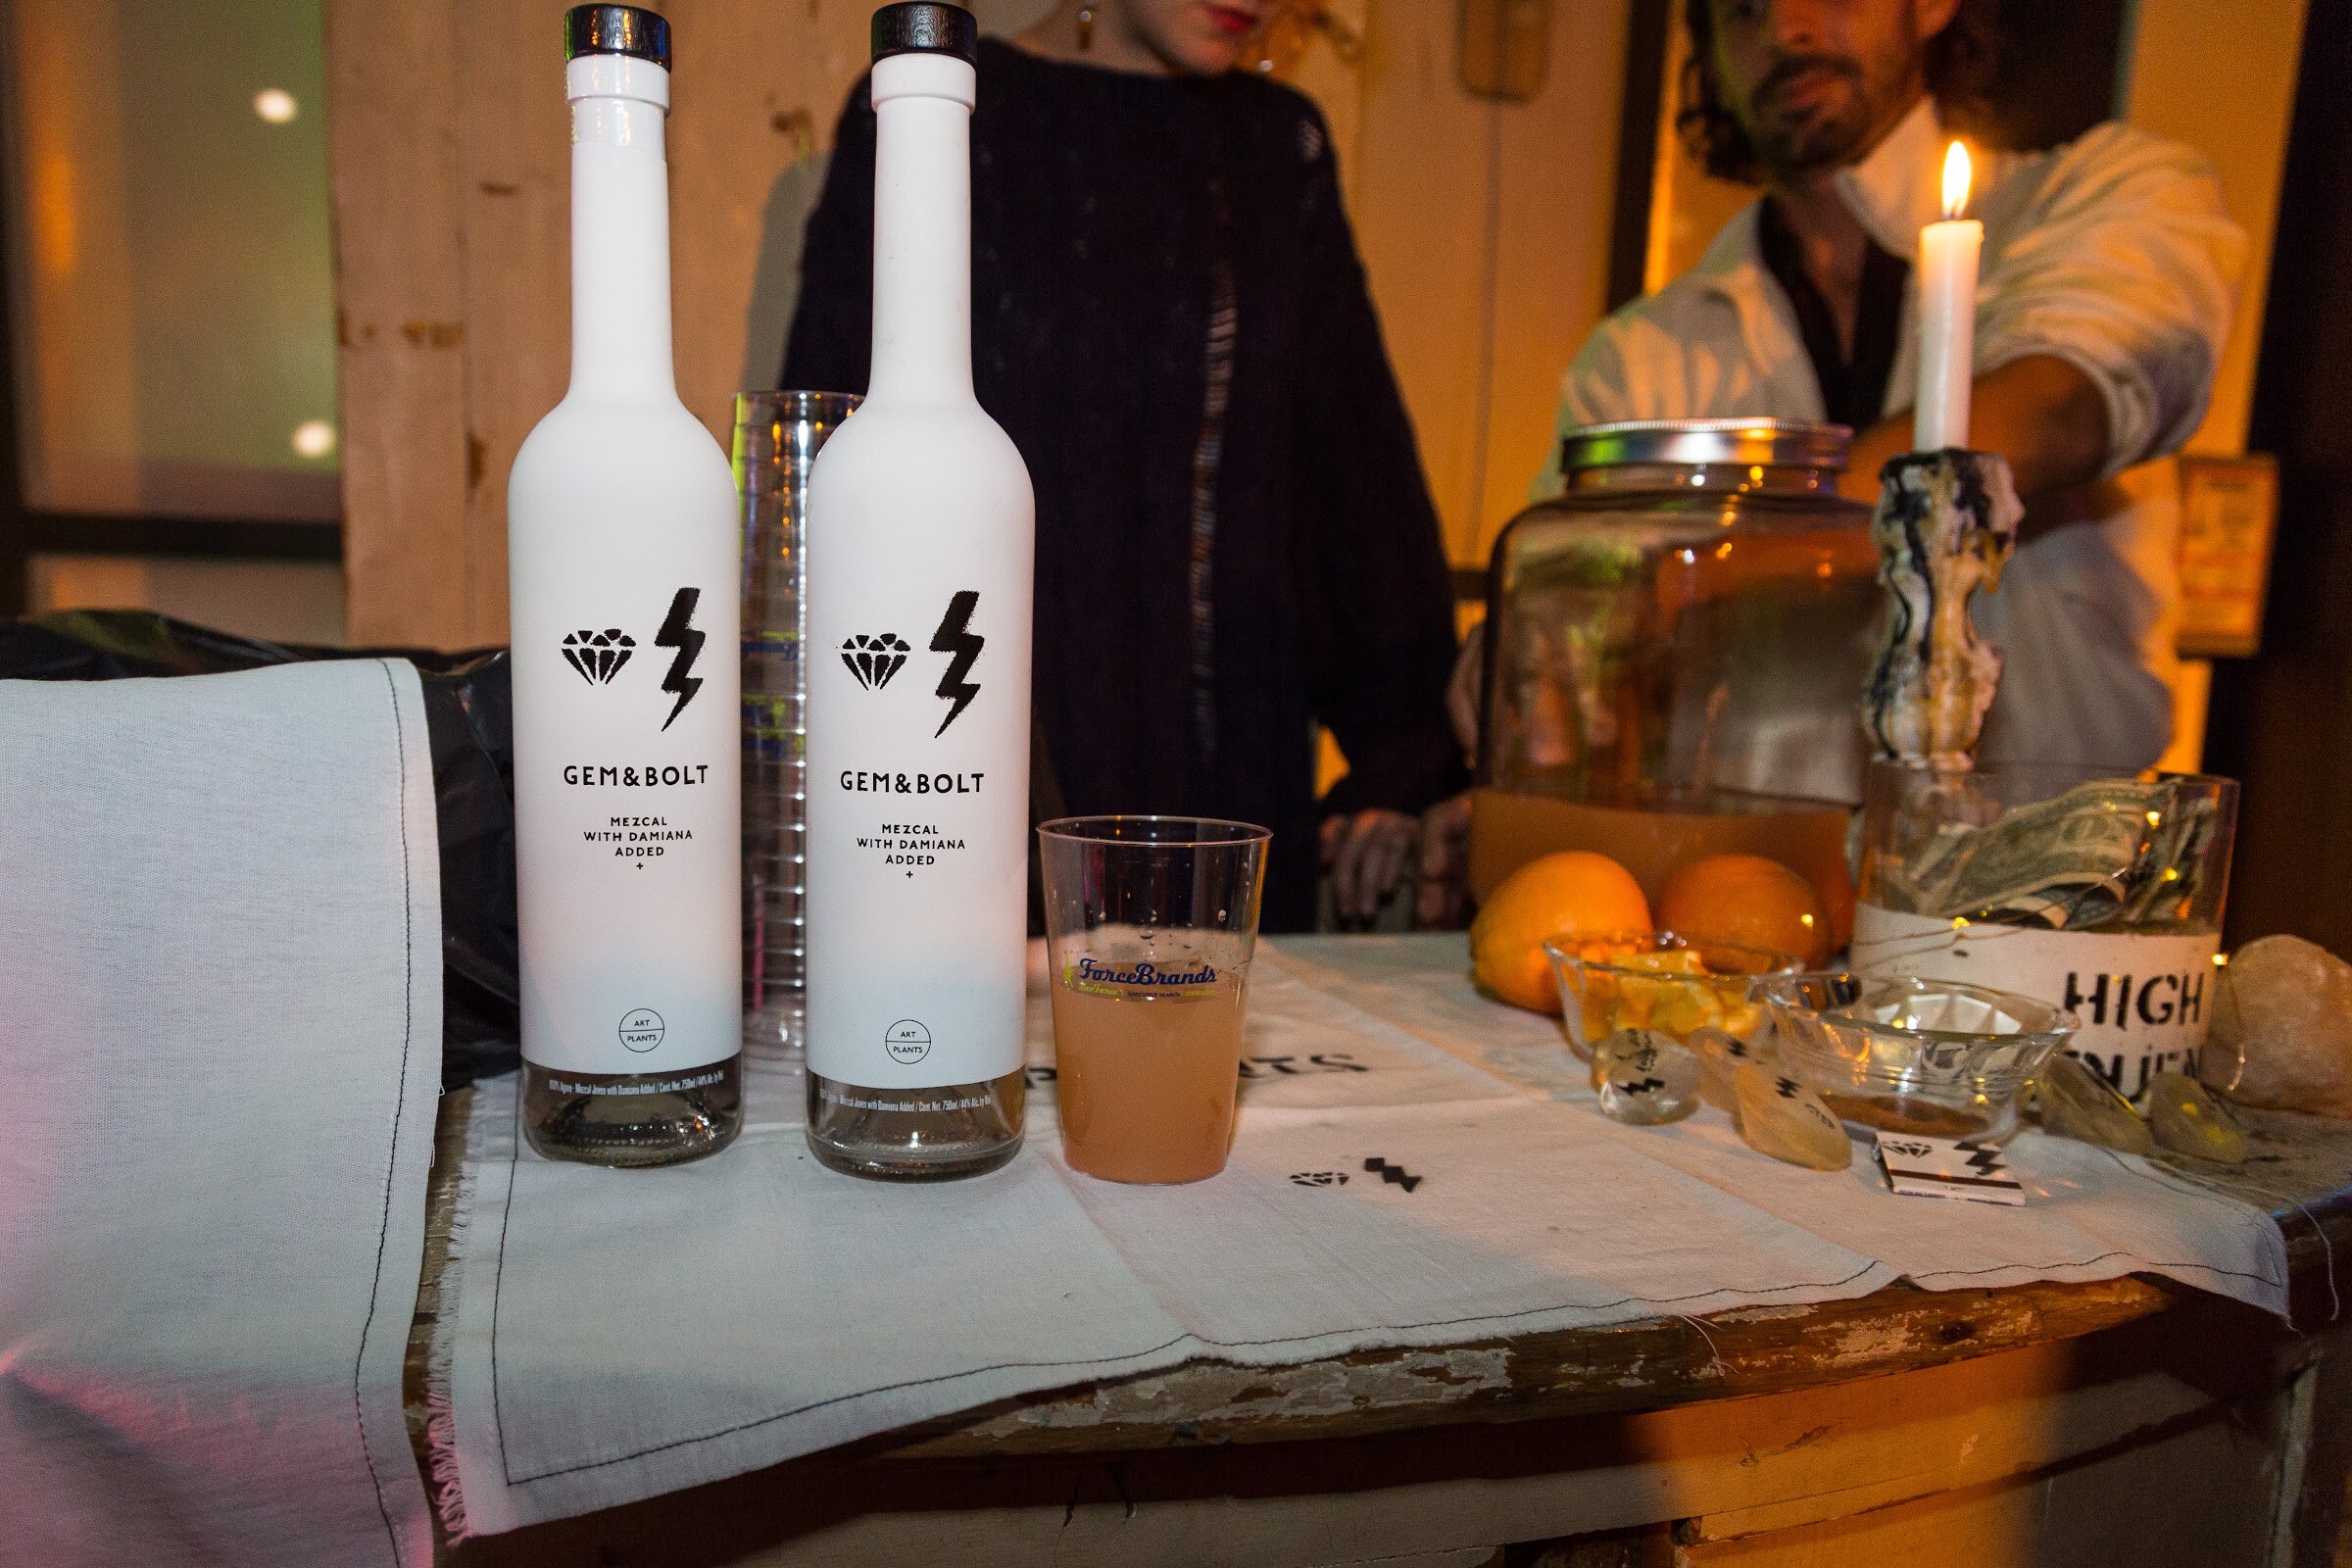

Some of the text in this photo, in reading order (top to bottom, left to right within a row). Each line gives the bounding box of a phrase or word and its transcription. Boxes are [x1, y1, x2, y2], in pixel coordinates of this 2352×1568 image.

[564, 764, 709, 787] GEM&BOLT
[840, 770, 985, 794] GEM&BOLT
[610, 816, 668, 827] MEZCAL
[881, 823, 940, 835] MEZCAL
[583, 829, 694, 843] WITH DAMIANA
[856, 837, 966, 851] WITH DAMIANA
[614, 846, 664, 858] ADDED
[884, 854, 936, 866] ADDED
[1079, 957, 1218, 986] ForceBrands
[2064, 971, 2205, 1029] HIGH
[626, 1034, 658, 1043] PLANTS
[893, 1045, 923, 1054] PLANTS
[640, 1083, 656, 1095] Added
[899, 1101, 914, 1112] Added
